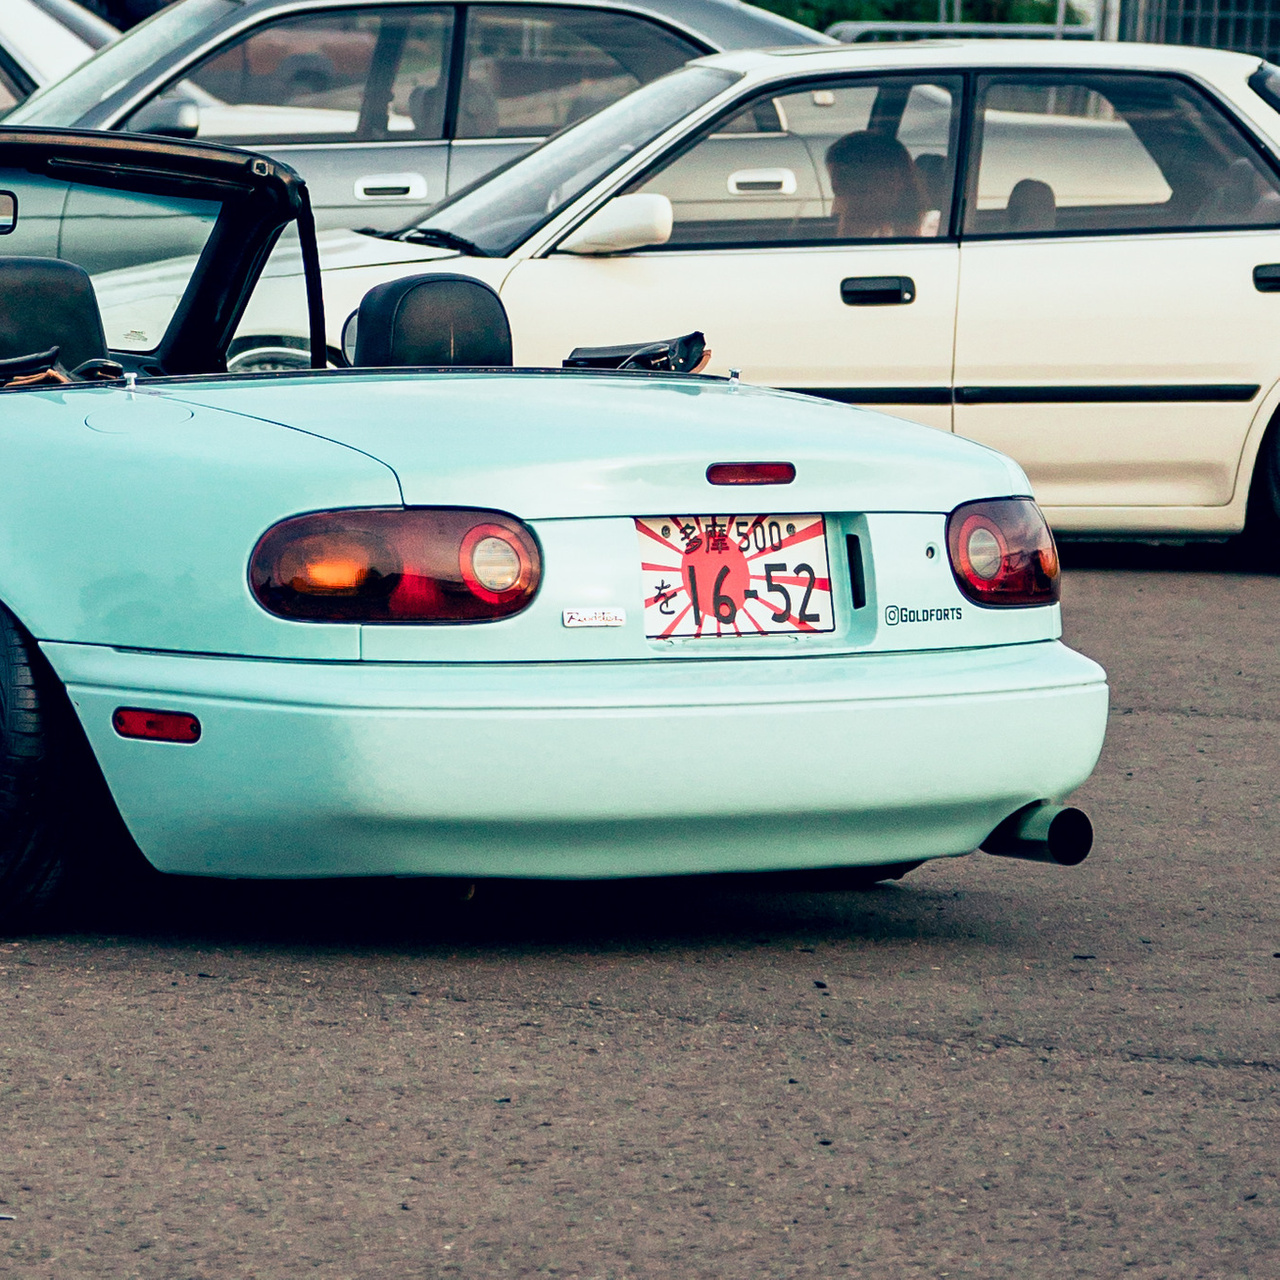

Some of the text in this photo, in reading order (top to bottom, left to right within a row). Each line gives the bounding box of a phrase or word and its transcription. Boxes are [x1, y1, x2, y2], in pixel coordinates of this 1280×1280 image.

[735, 520, 783, 552] 500
[653, 563, 821, 626] を 16-52
